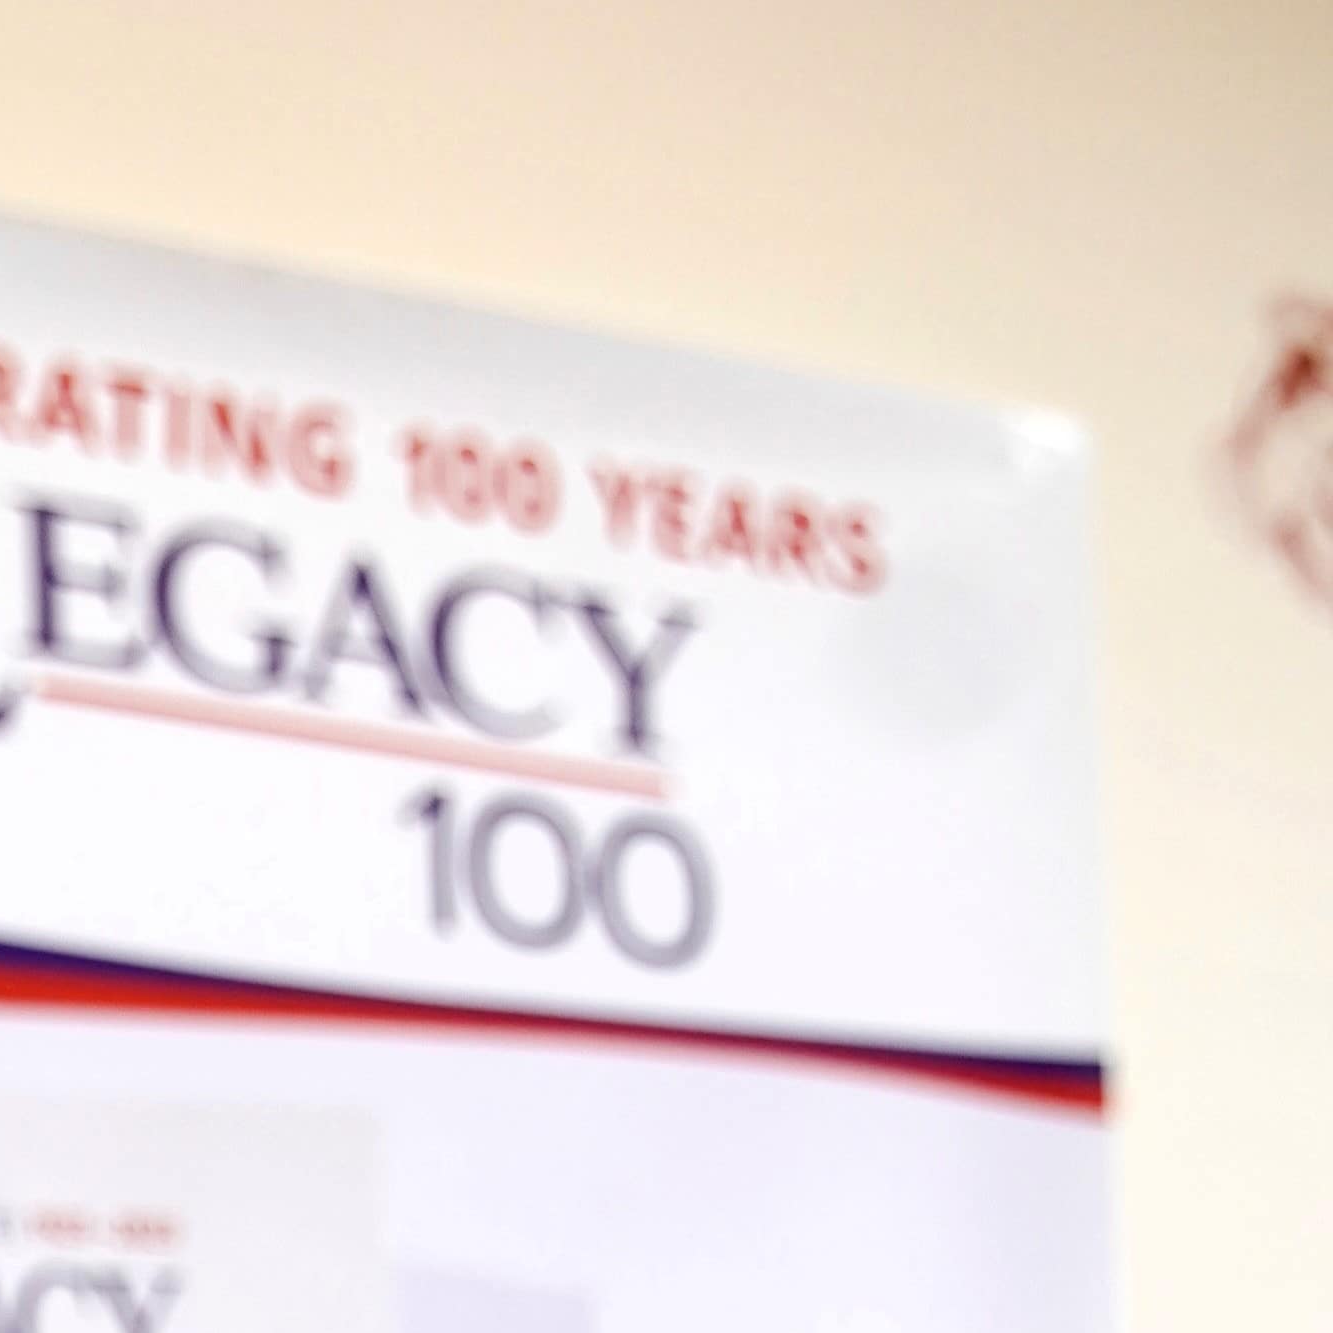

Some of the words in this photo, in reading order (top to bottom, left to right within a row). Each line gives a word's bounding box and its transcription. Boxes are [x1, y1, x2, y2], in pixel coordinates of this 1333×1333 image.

[391, 428, 565, 534] 100
[585, 455, 891, 598] YEARS
[397, 786, 719, 974] 100
